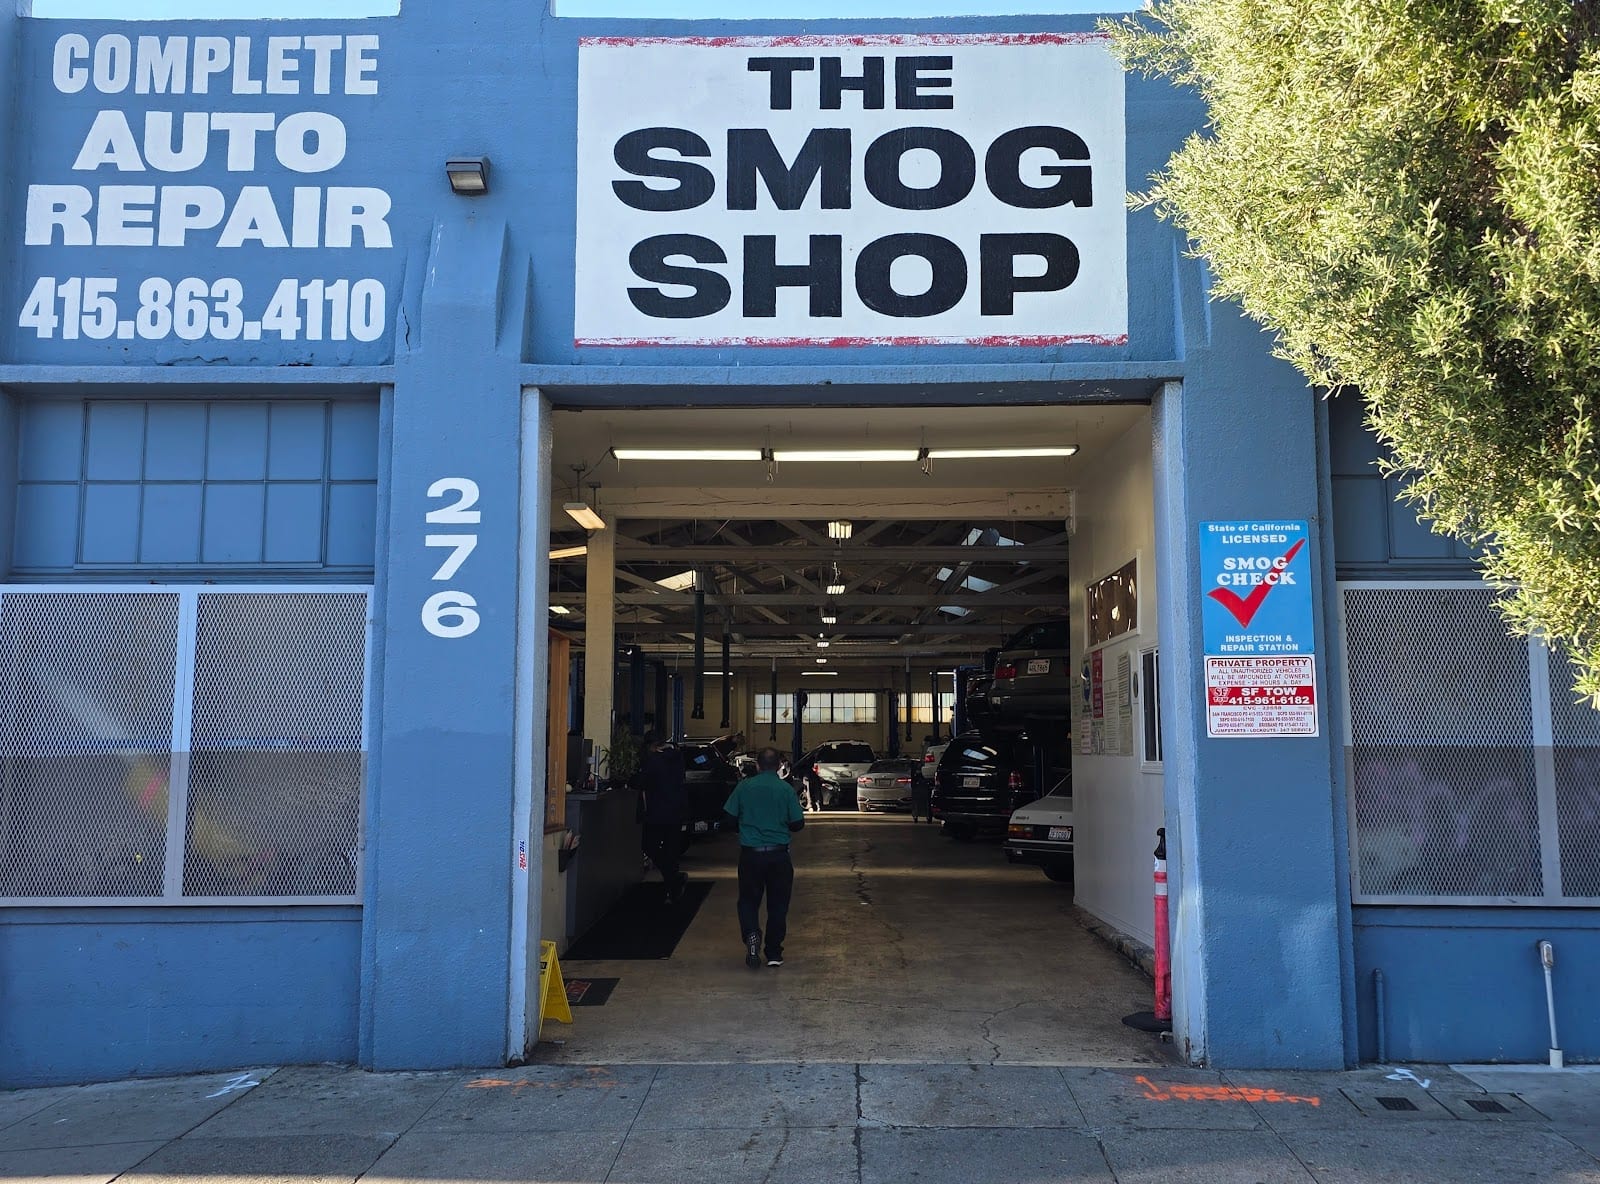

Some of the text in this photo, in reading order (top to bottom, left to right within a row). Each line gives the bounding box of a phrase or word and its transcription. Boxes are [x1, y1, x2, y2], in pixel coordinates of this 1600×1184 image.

[53, 33, 379, 95] COMPLETE
[747, 56, 953, 110] THE
[72, 110, 347, 172] AUTO
[611, 125, 1093, 211] SMOG
[24, 184, 393, 248] REPAIR
[626, 232, 1080, 318] SHOP
[18, 277, 386, 341] 415.863.4110
[1208, 523, 1301, 532] State of California
[1222, 534, 1287, 544] LICENSED
[1223, 556, 1289, 570] SMOG
[1216, 572, 1297, 586] CHECK
[1225, 635, 1282, 643] INSPECTION
[1220, 643, 1299, 652] REPAIR STATION
[1256, 659, 1308, 667] PROPERTY
[1241, 687, 1297, 696] SF TOW
[1229, 696, 1310, 705] 415-961-6182
